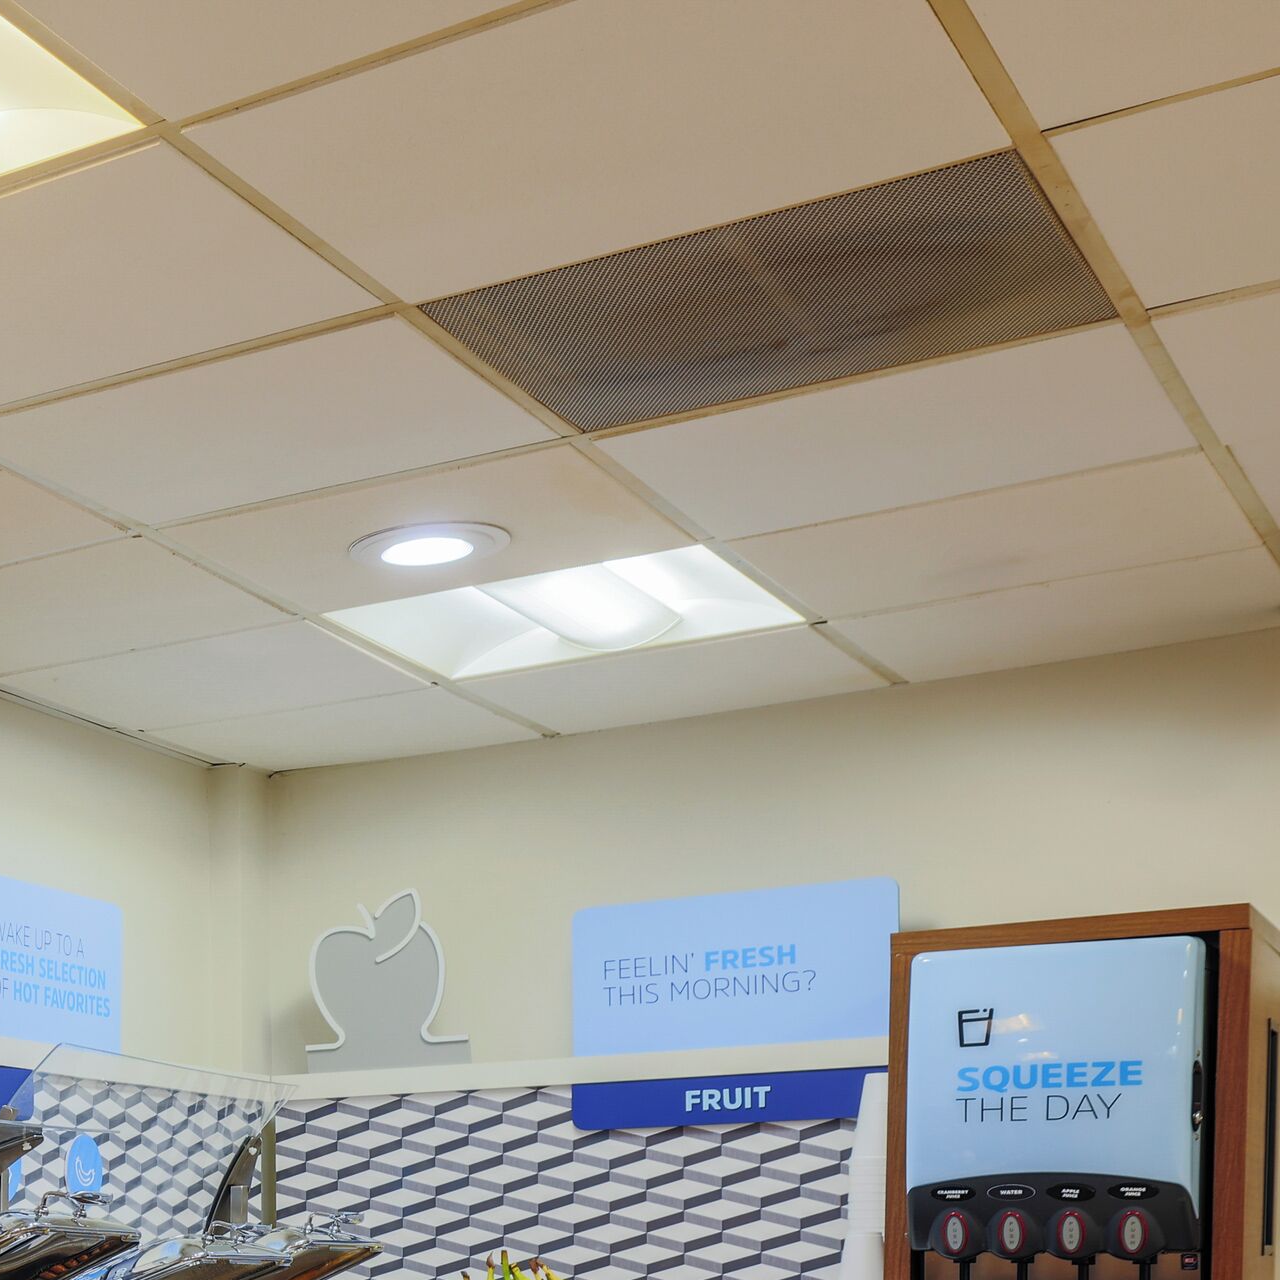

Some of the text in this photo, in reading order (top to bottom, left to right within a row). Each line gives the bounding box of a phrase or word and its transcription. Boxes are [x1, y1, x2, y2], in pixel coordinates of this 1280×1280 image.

[35, 928, 52, 951] UP
[56, 932, 72, 956] TO
[77, 938, 85, 959] A
[704, 944, 797, 972] FRESH
[39, 958, 106, 990] SELECTION
[603, 969, 817, 1007] THIS MORNING?
[13, 979, 40, 1005] HOT
[44, 985, 111, 1018] FAVORITES
[956, 1060, 1144, 1093] SQUEEZE
[684, 1085, 772, 1112] FRUIT
[955, 1092, 1123, 1123] THE DAY
